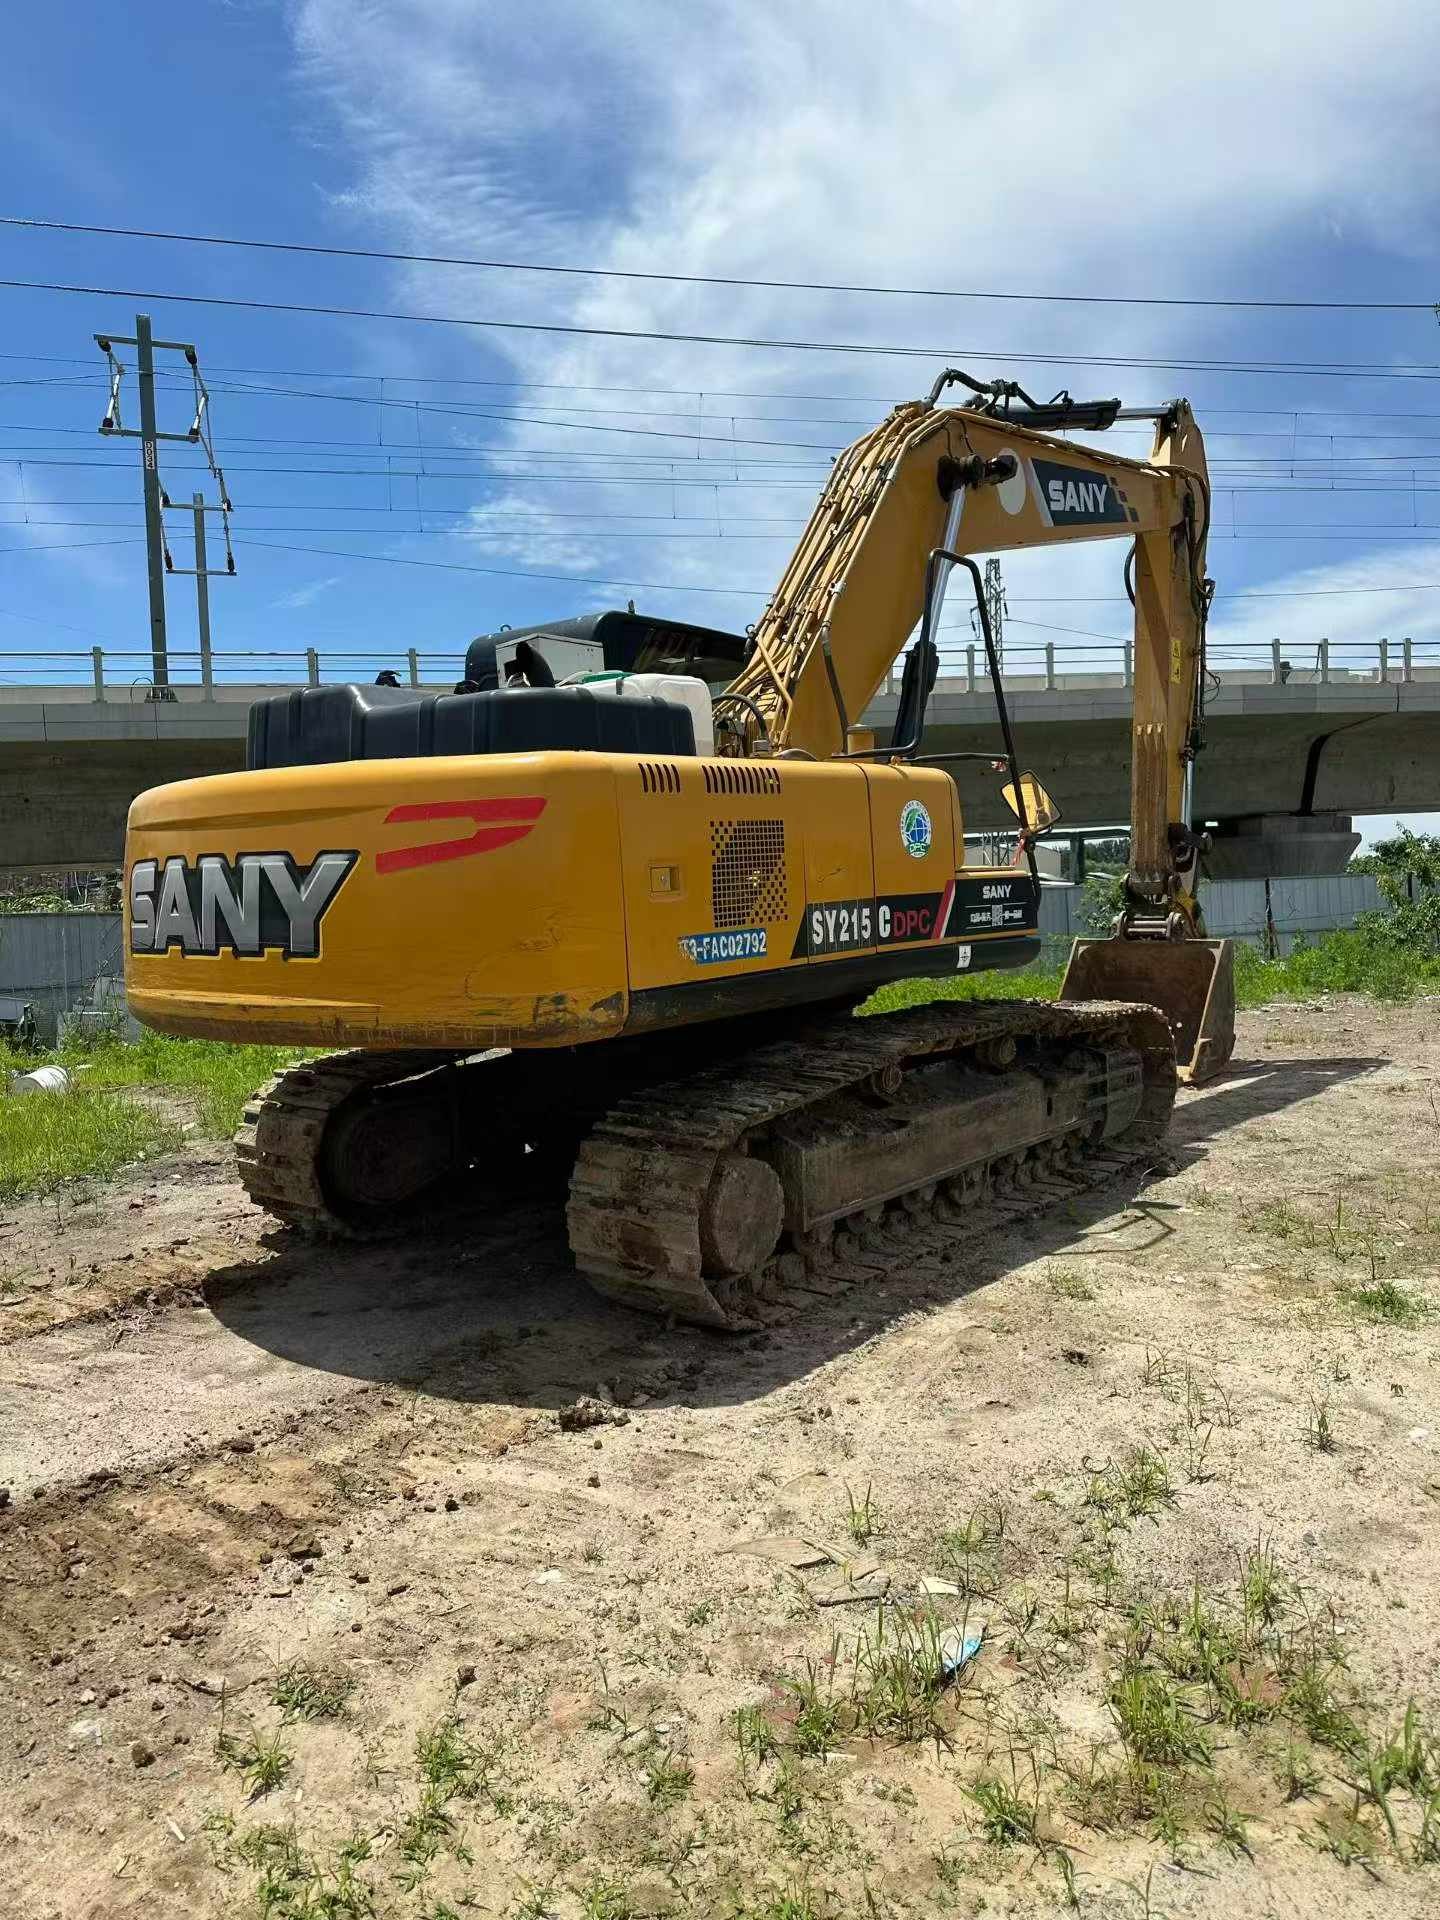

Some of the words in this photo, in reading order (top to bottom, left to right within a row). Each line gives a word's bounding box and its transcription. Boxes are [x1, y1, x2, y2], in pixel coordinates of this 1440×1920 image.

[1048, 480, 1107, 513] SANY
[130, 851, 353, 956] SANY
[982, 884, 1012, 899] SANY
[893, 908, 931, 937] DPC
